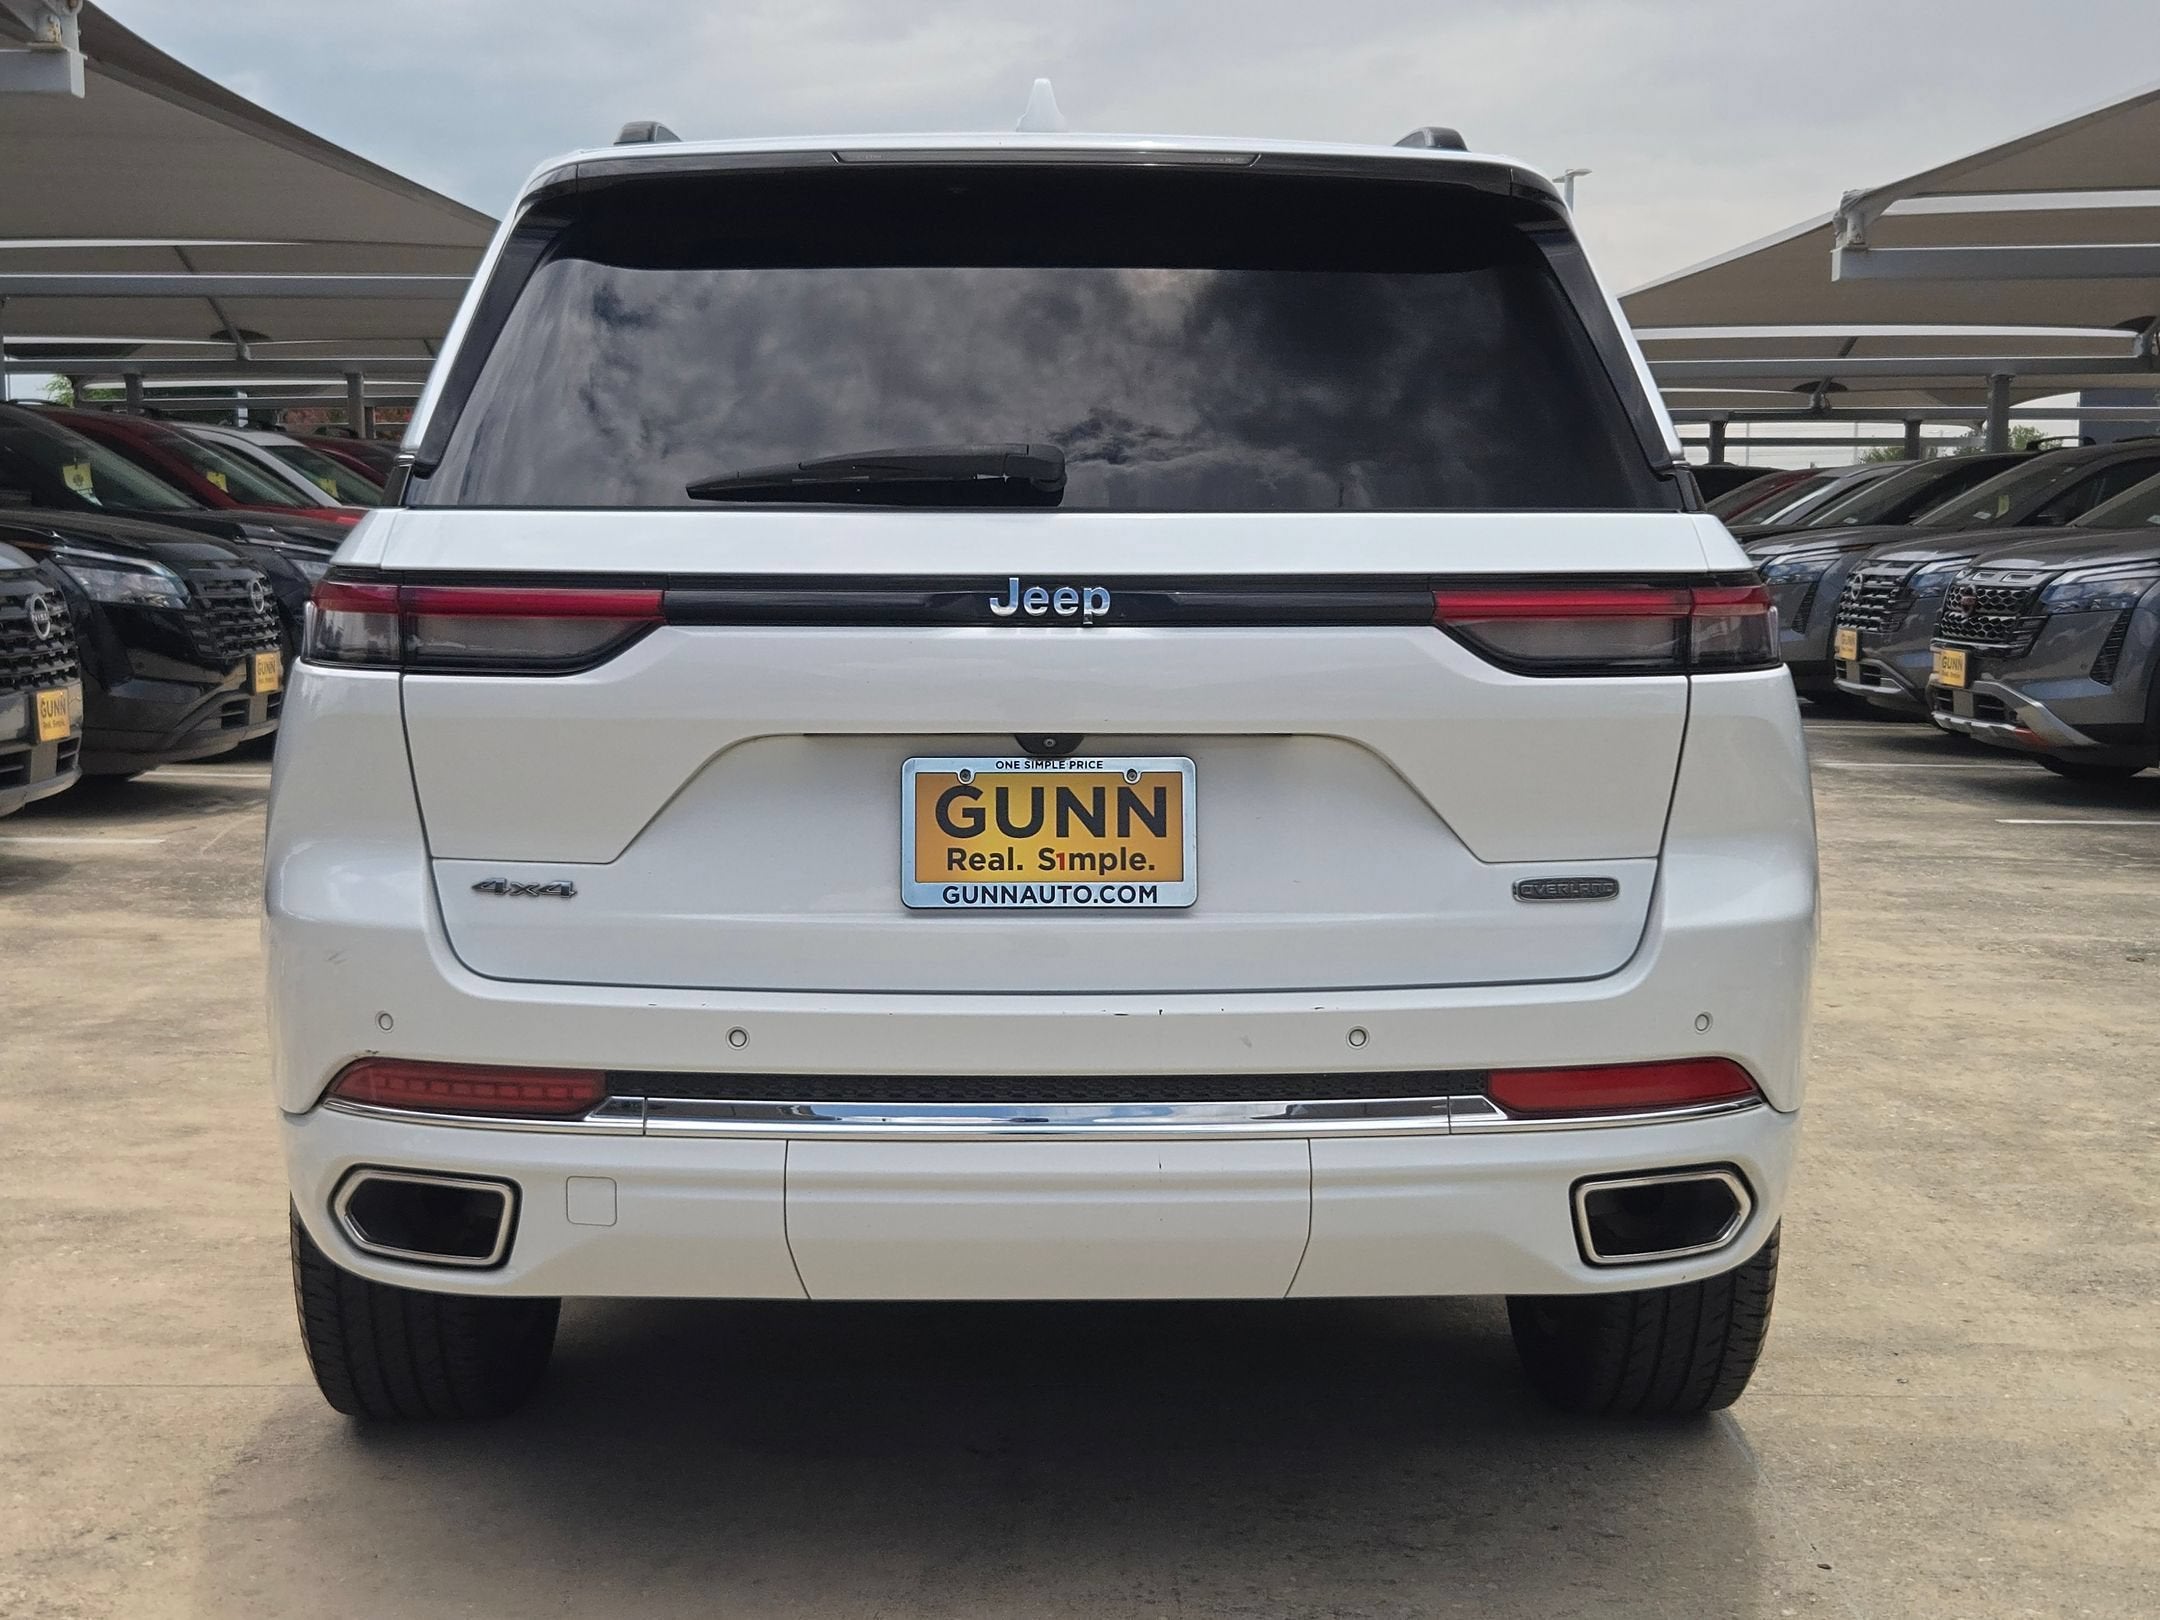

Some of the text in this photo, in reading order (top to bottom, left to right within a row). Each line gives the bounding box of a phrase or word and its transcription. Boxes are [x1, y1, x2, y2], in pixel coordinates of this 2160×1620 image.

[989, 577, 1111, 625] Jeep
[40, 697, 66, 718] GUNN
[995, 760, 1104, 769] ONE SIMPLE PRICE
[935, 785, 1167, 838] GUNN
[947, 847, 1023, 871] Real.
[942, 885, 1158, 904] GUNNAUTO.COM
